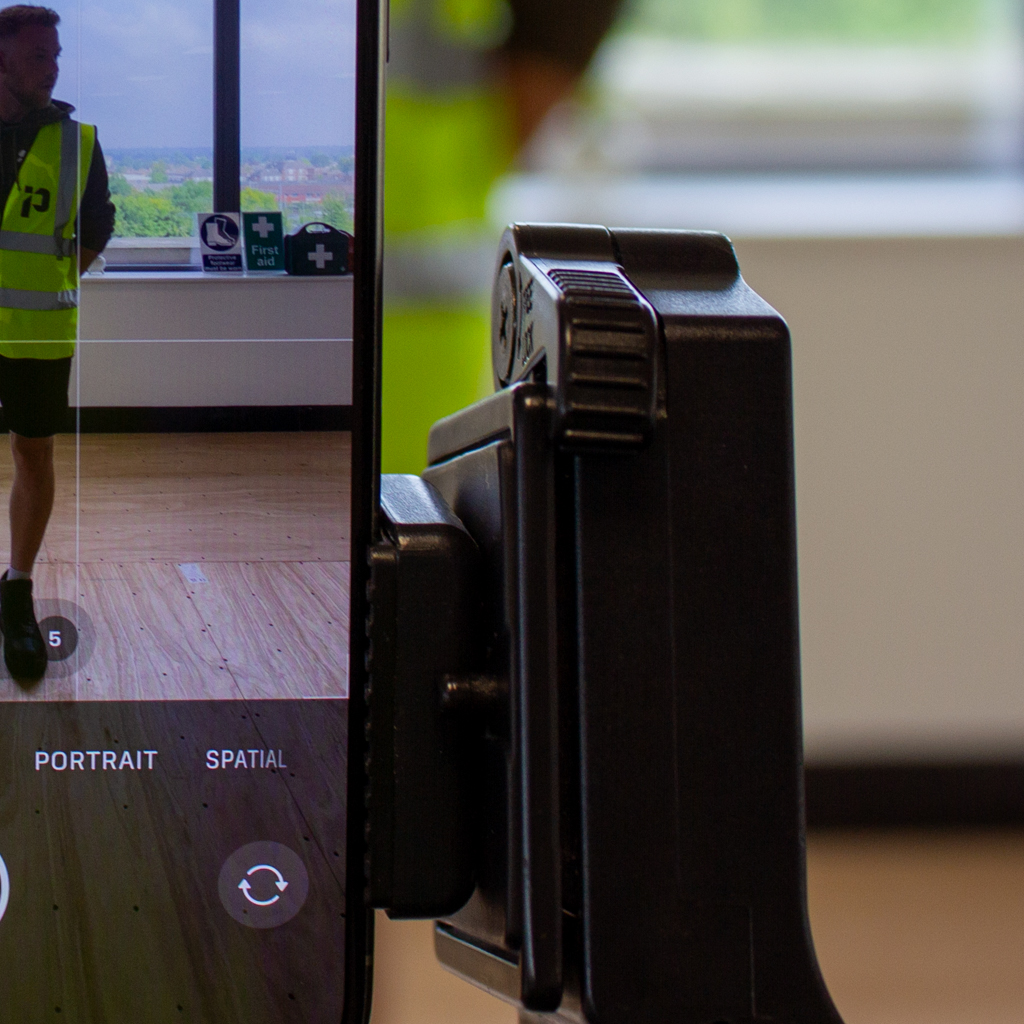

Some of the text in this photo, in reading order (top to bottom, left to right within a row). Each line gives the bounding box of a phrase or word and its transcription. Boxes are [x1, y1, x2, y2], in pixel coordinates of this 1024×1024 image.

[251, 244, 279, 256] First
[257, 256, 275, 267] aid
[48, 630, 62, 647] 5
[34, 750, 158, 771] PORTRAIT
[205, 749, 288, 770] SPATIAL
